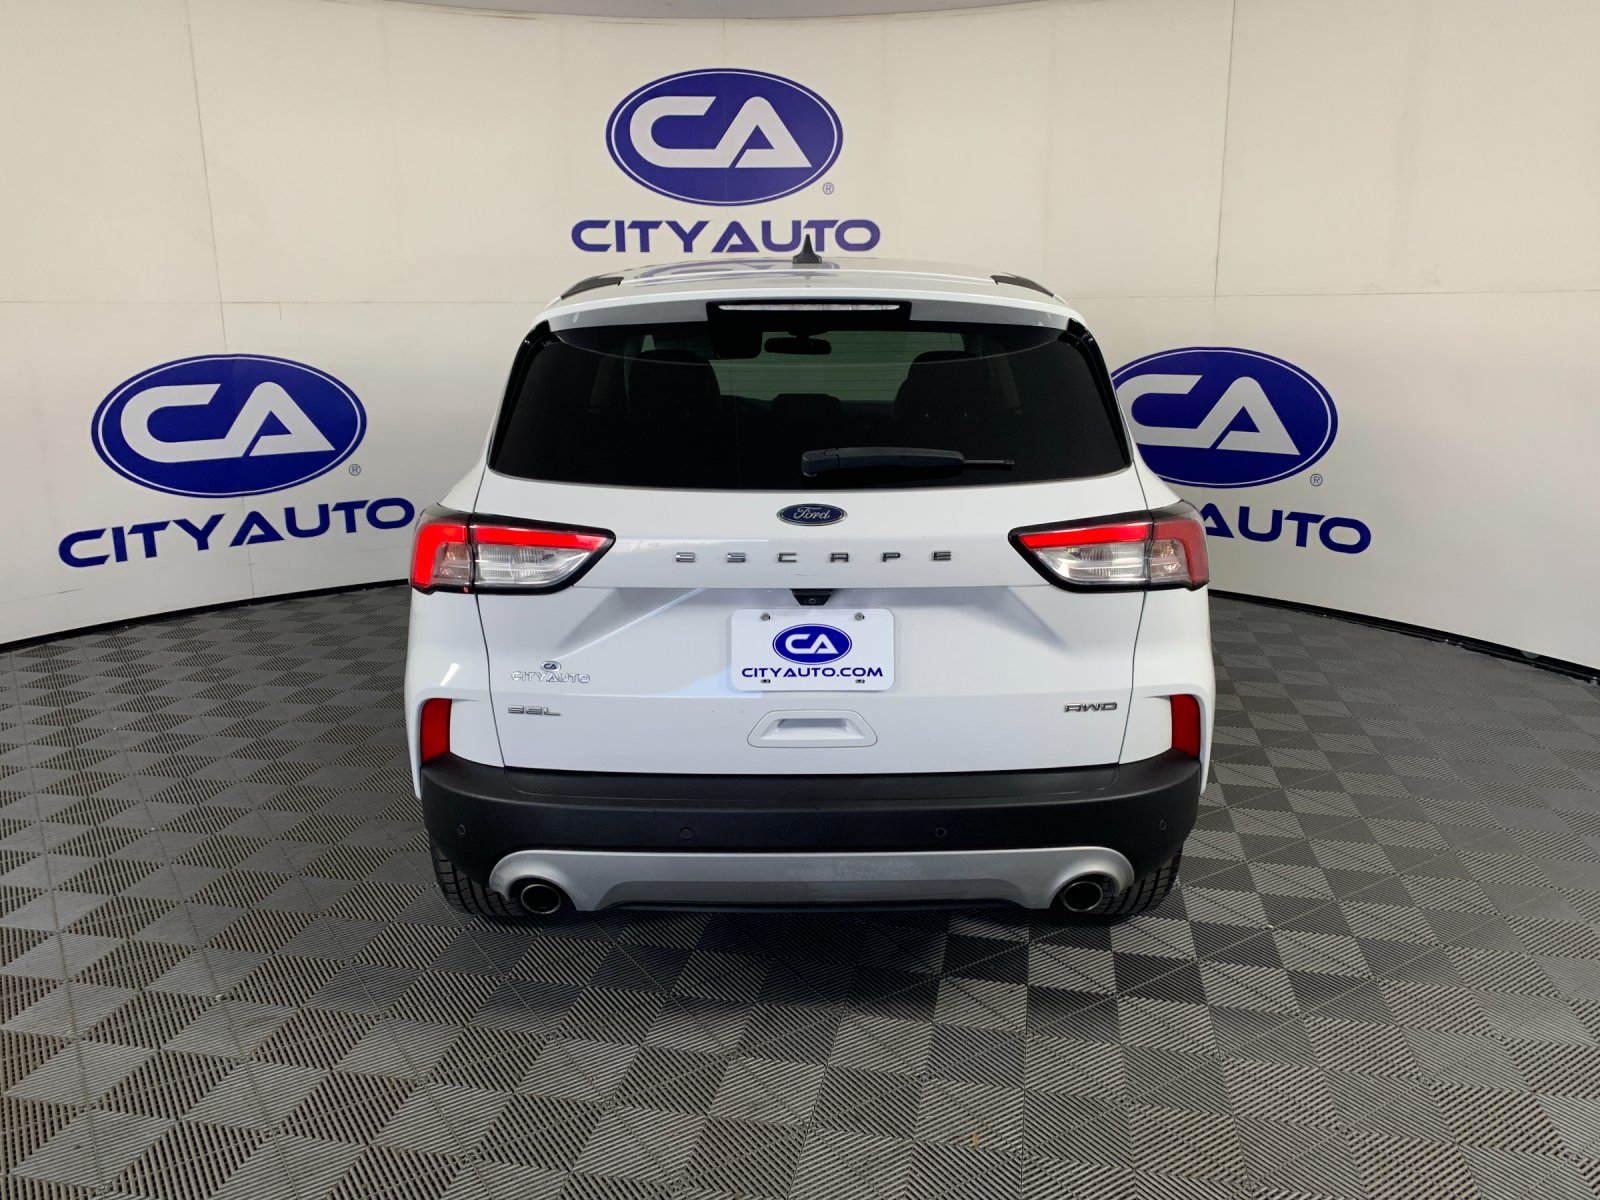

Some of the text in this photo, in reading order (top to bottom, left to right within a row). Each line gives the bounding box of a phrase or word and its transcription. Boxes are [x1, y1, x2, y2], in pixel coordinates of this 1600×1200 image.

[629, 95, 813, 168] CA
[1114, 373, 1301, 456] CA
[120, 381, 336, 463] CA
[793, 506, 831, 519] Ford
[675, 550, 952, 563] ESCAPE
[785, 633, 839, 655] CA
[741, 667, 884, 678] CITYAUTO.COM
[507, 705, 562, 717] SEL
[1064, 702, 1118, 713] AWD
